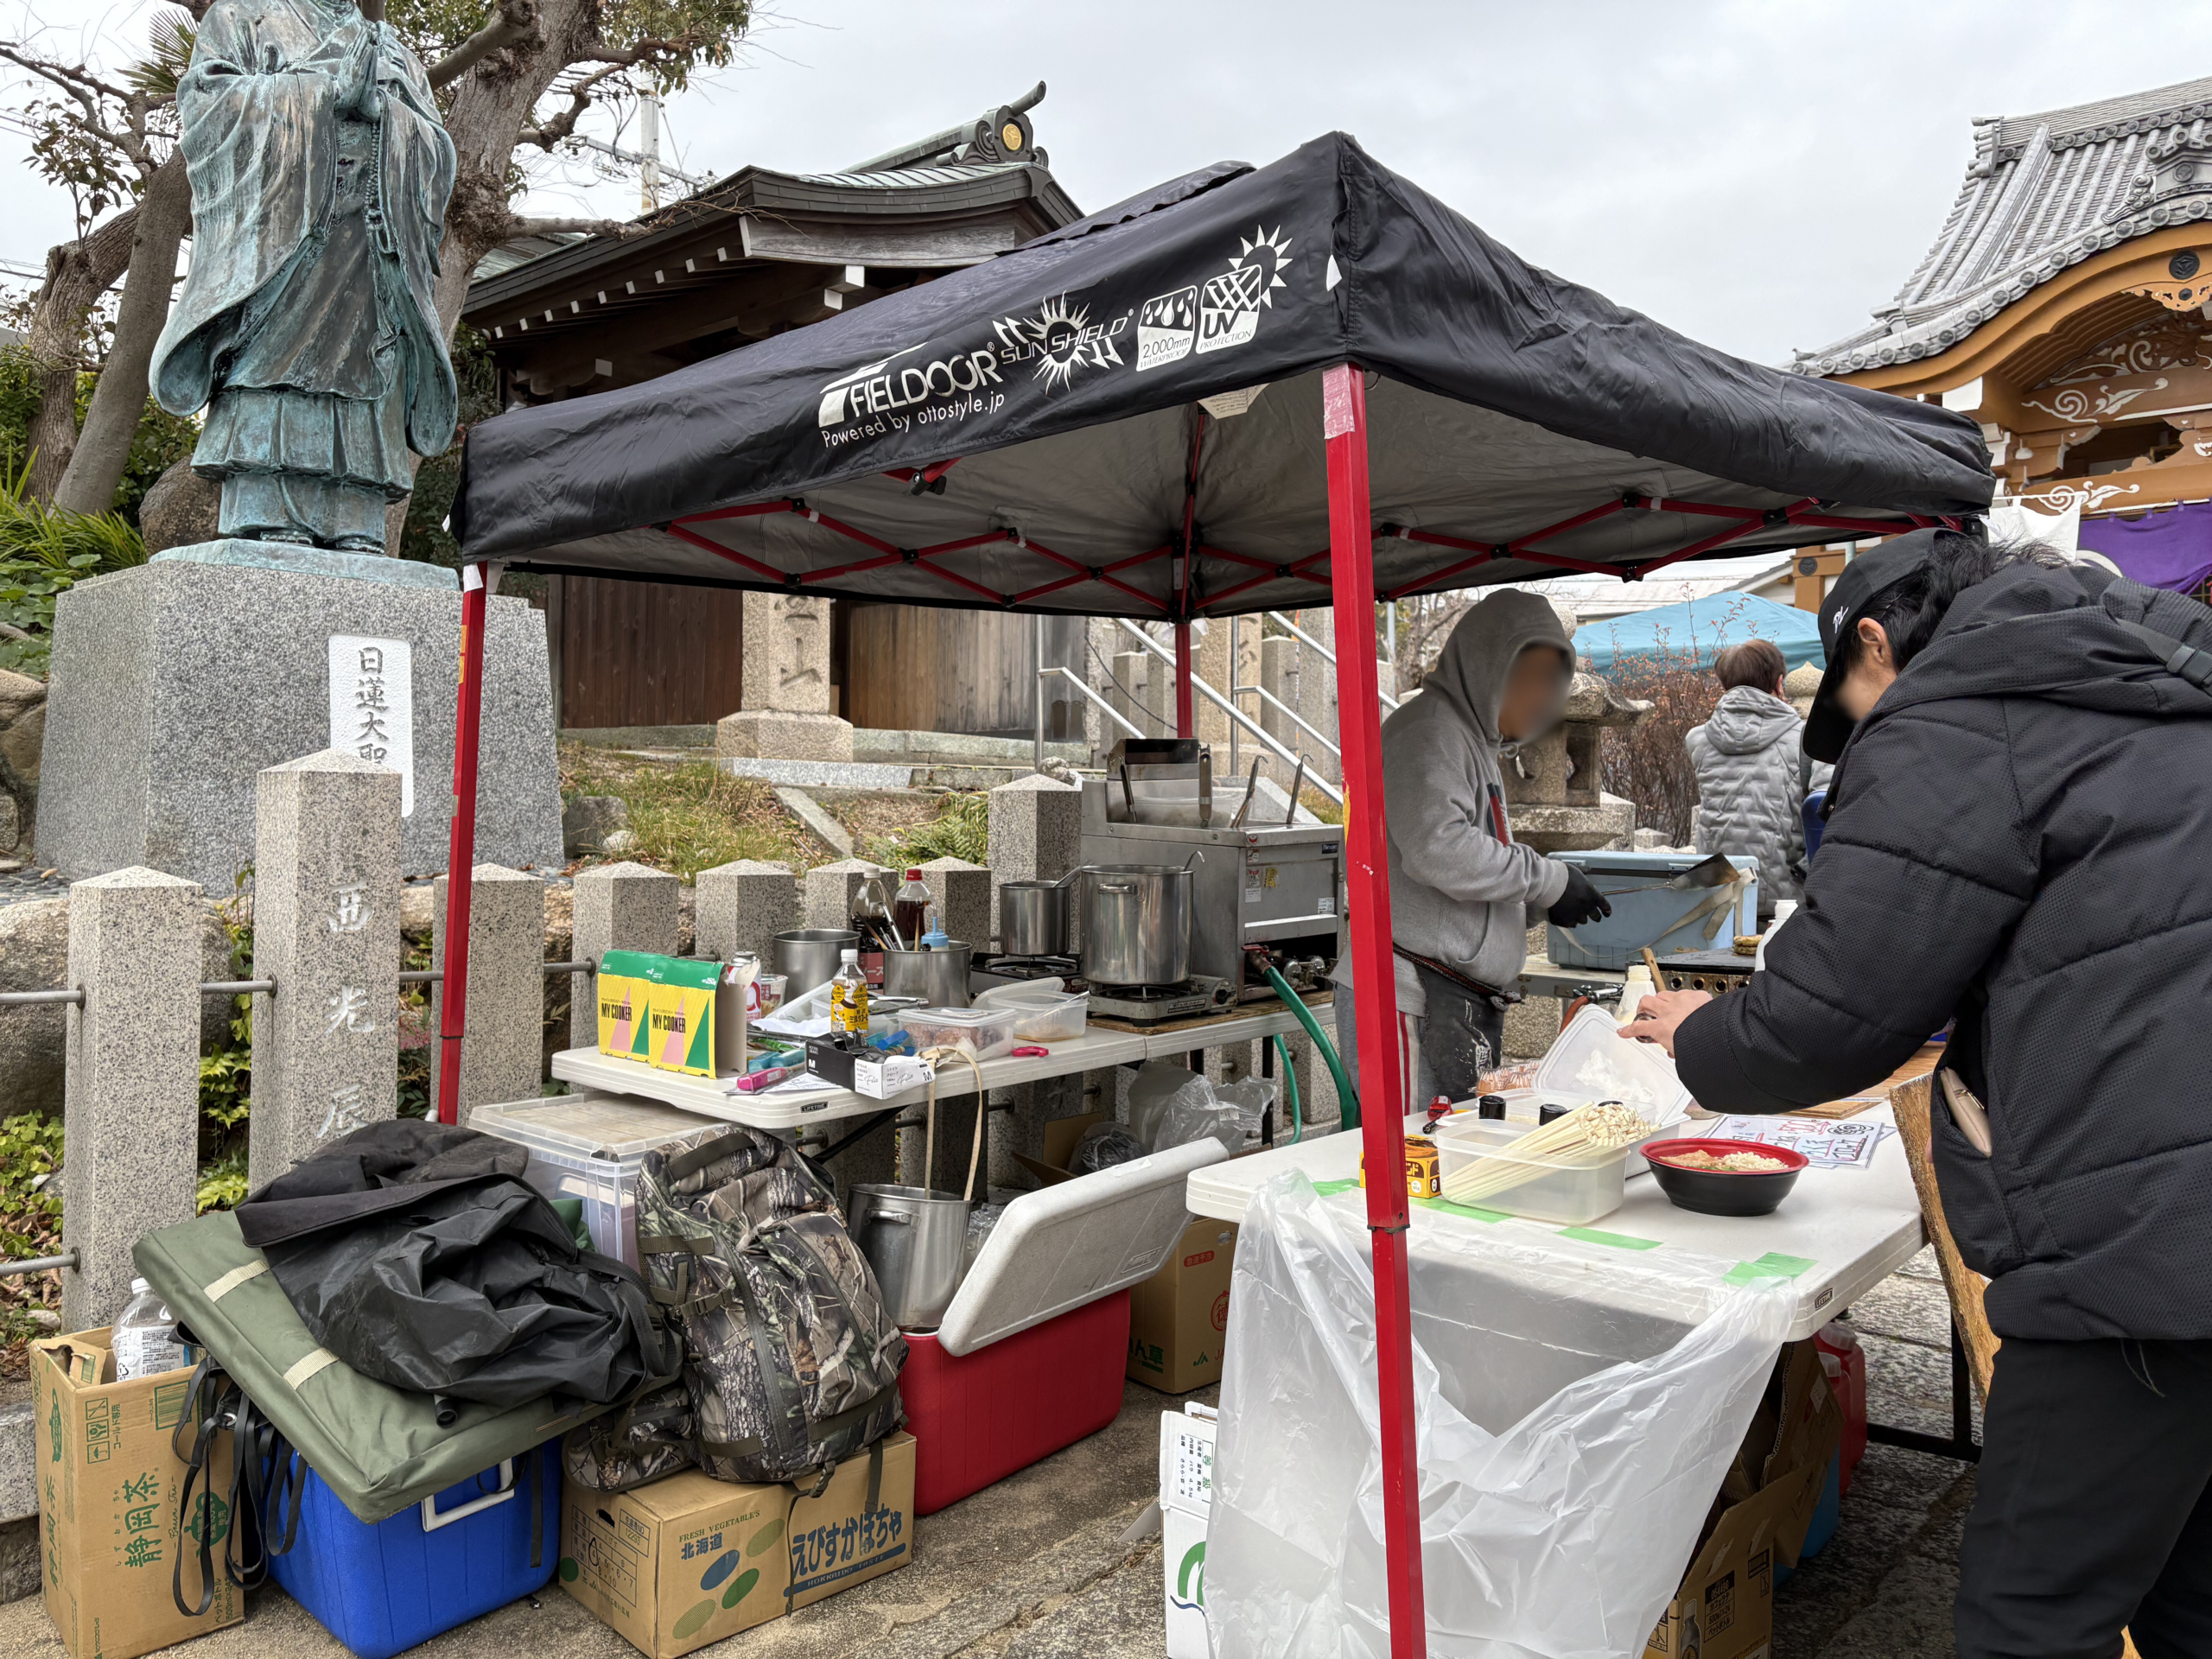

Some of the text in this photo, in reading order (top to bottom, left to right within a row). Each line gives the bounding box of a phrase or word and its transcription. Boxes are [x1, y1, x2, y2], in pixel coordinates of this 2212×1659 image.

[1204, 309, 1241, 340] UV
[1001, 316, 1128, 365] SUN SHIELD
[1142, 336, 1191, 359] 2,000mm
[1199, 329, 1252, 350] PROTECTION
[823, 389, 1005, 448] Powered by ottostyle.jp
[601, 1002, 610, 1018] MY
[611, 1004, 632, 1022] COOKER
[652, 1014, 686, 1034] MY COOKER
[808, 1058, 816, 1069] M
[923, 1071, 932, 1081] M
[804, 1103, 825, 1111] LIFETIME
[1186, 1251, 1212, 1266] 急速予冷
[112, 1403, 122, 1449] コールド専用
[123, 1472, 162, 1568] 静岡茶
[678, 1509, 760, 1543] FRESH VEGETABLE'S
[625, 1528, 641, 1546] 12293
[680, 1532, 723, 1561] 北海道
[791, 1503, 902, 1579] えびすかぼちゃ
[807, 1566, 854, 1588] HOKKAIDO
[213, 1578, 223, 1623] ペットボトル
[1709, 1592, 1731, 1612] カフェラテ
